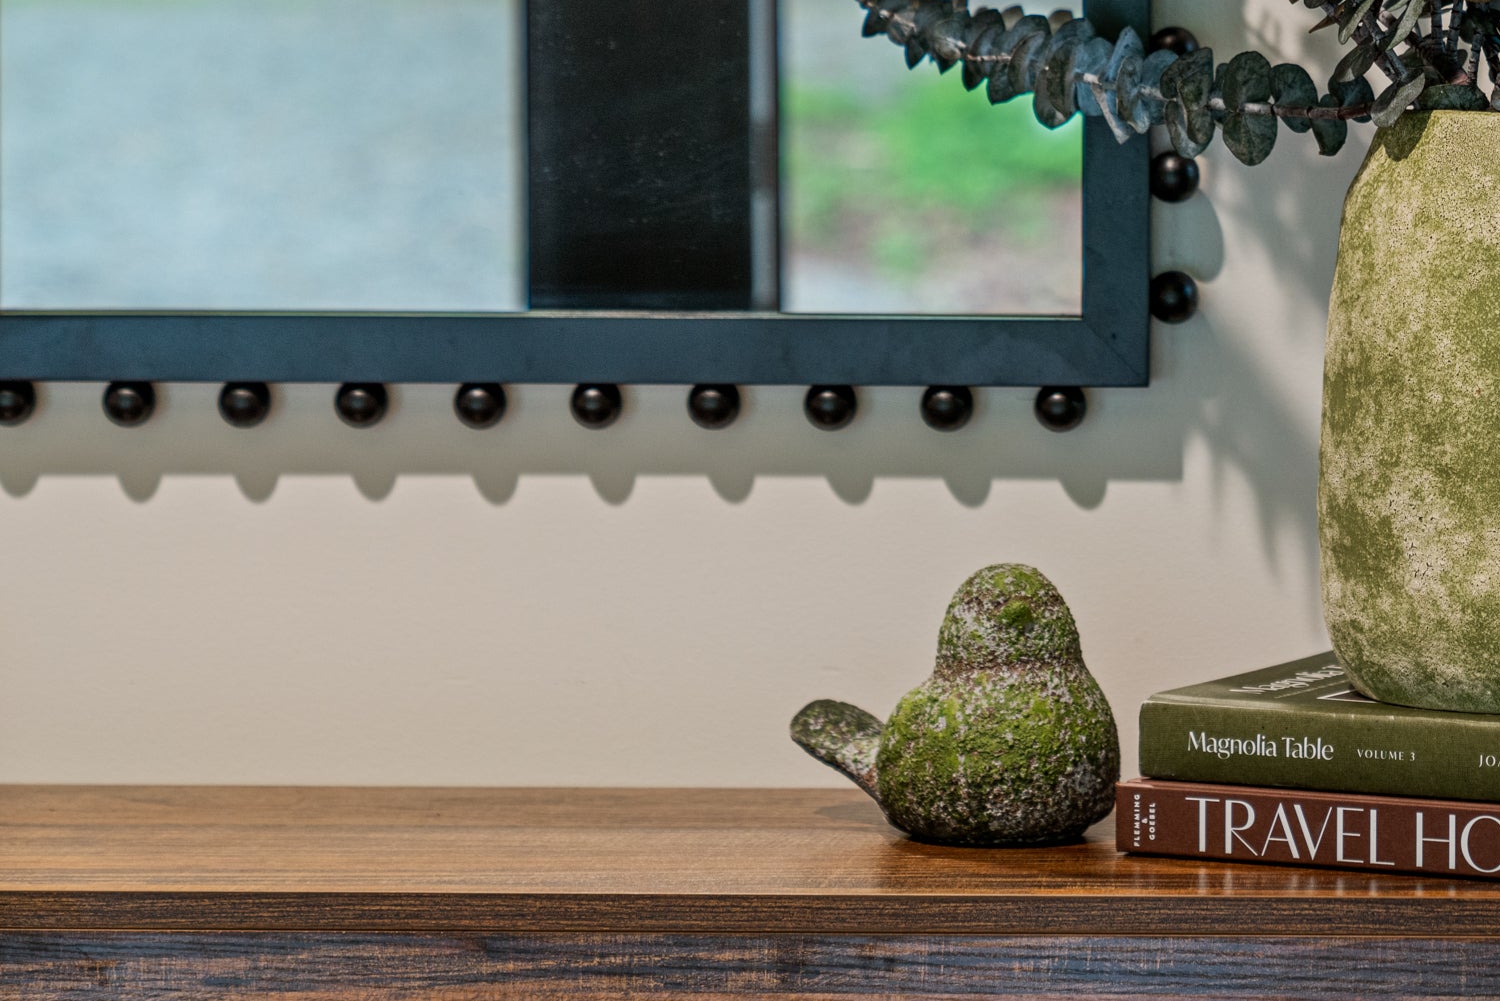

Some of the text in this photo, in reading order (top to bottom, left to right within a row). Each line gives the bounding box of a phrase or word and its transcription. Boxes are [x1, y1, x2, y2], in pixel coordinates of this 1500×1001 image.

[1187, 731, 1334, 761] Magnolia Table
[1357, 748, 1416, 762] VOLUME 3
[1133, 794, 1141, 847] FLEMMING
[1148, 802, 1156, 841] GOEBEL
[1184, 796, 1396, 866] TRAVEL
